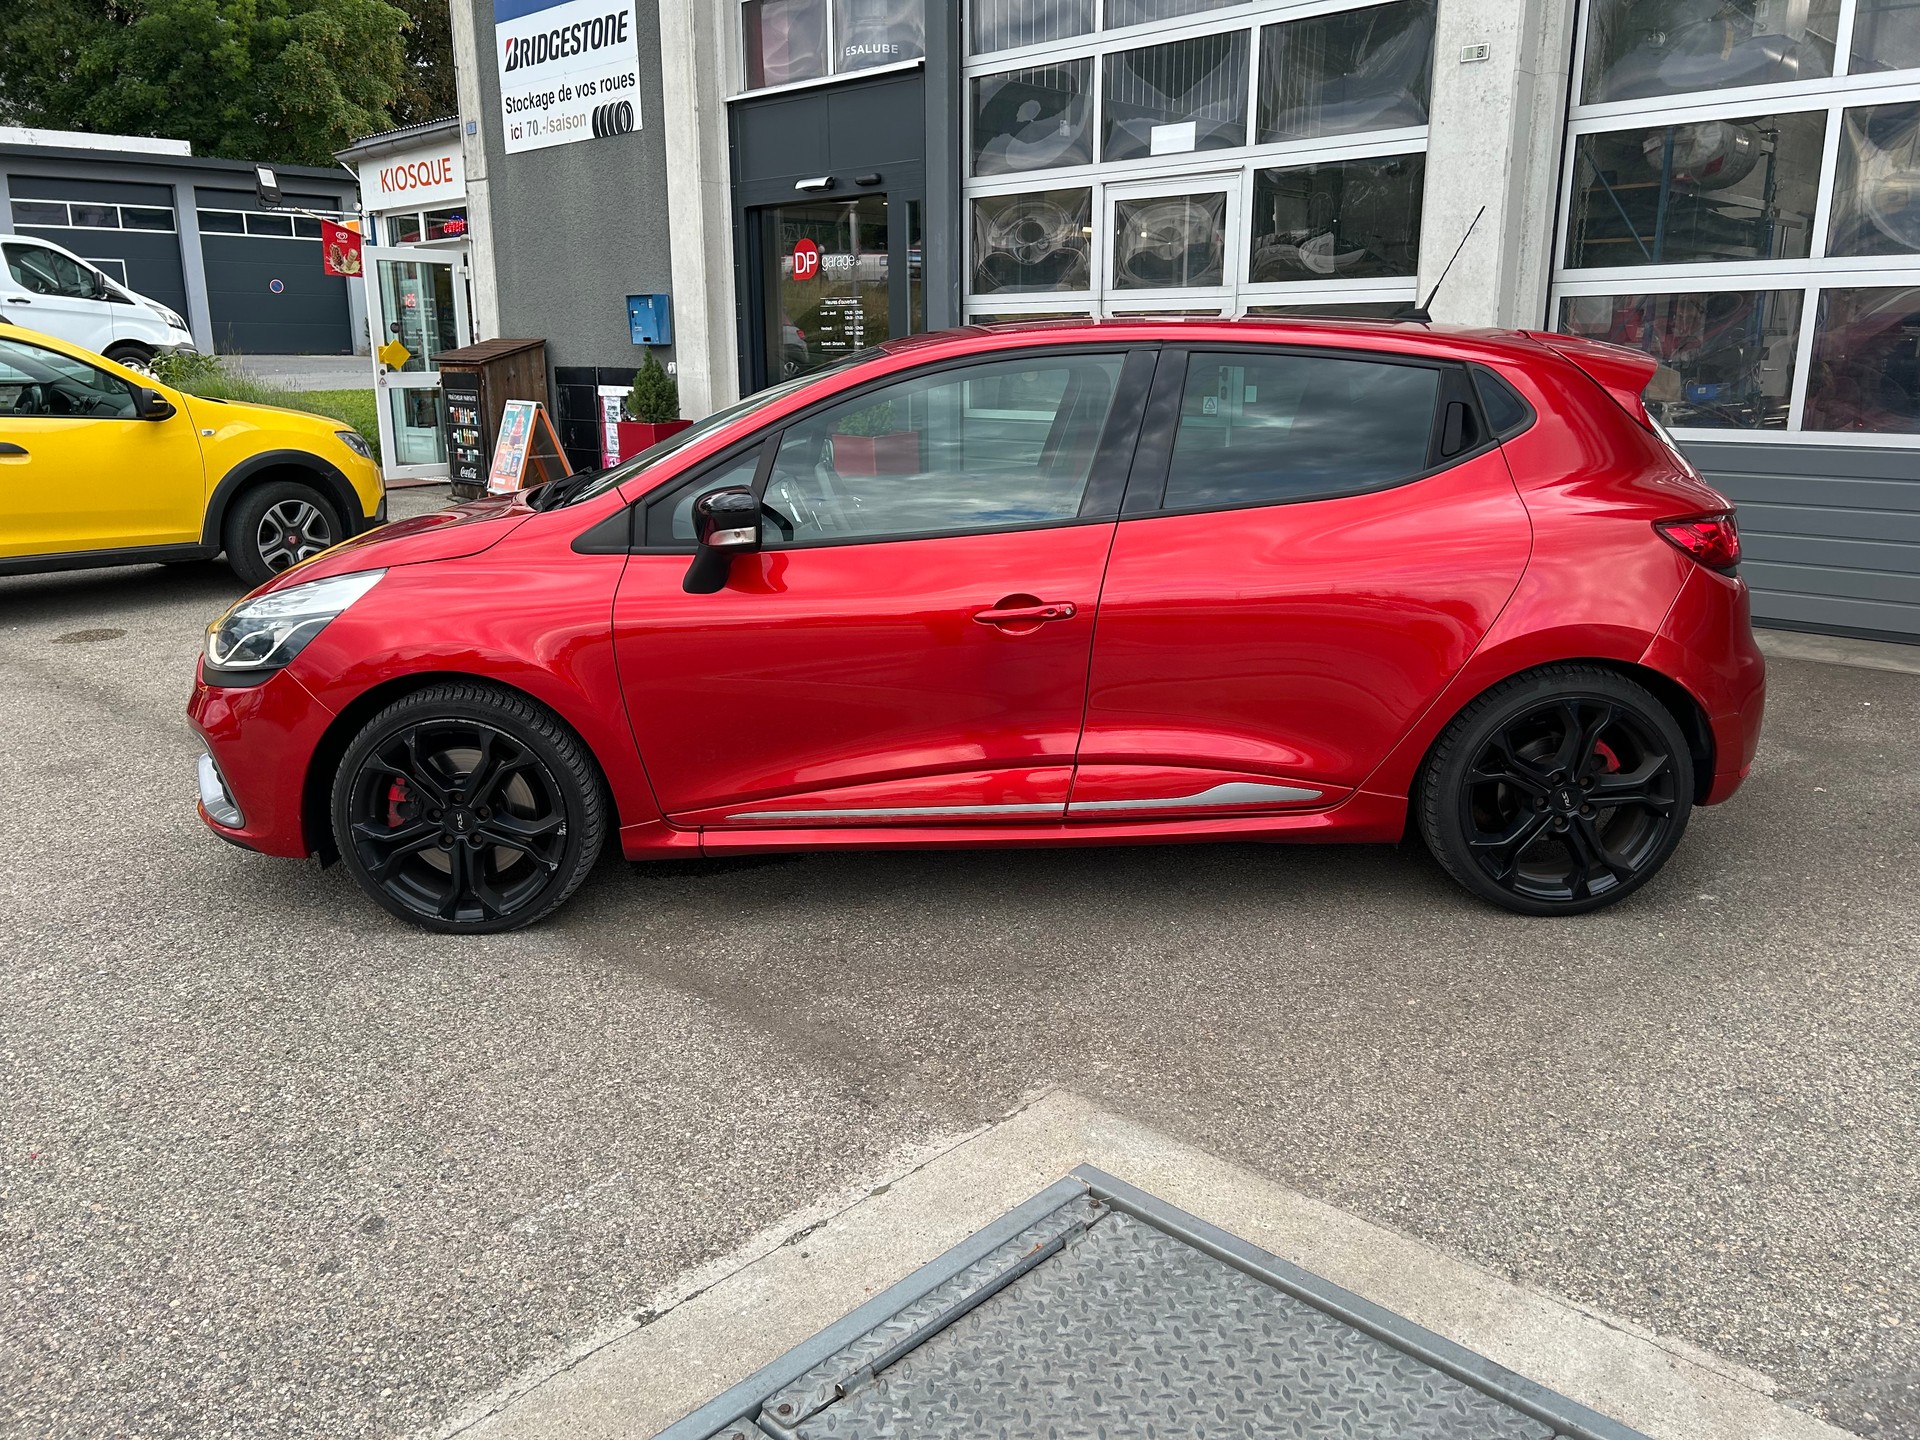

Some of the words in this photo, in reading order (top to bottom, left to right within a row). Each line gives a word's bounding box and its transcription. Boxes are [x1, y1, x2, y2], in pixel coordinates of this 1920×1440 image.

[504, 10, 629, 72] BRIDGESTONE
[845, 43, 899, 57] ESALUBE
[505, 91, 555, 114] Stockage
[558, 83, 572, 102] de
[575, 81, 597, 98] vos
[600, 72, 636, 93] roues
[510, 122, 523, 140] ici
[380, 157, 453, 193] KIOSQUE
[794, 251, 818, 274] DP
[821, 254, 855, 272] garage
